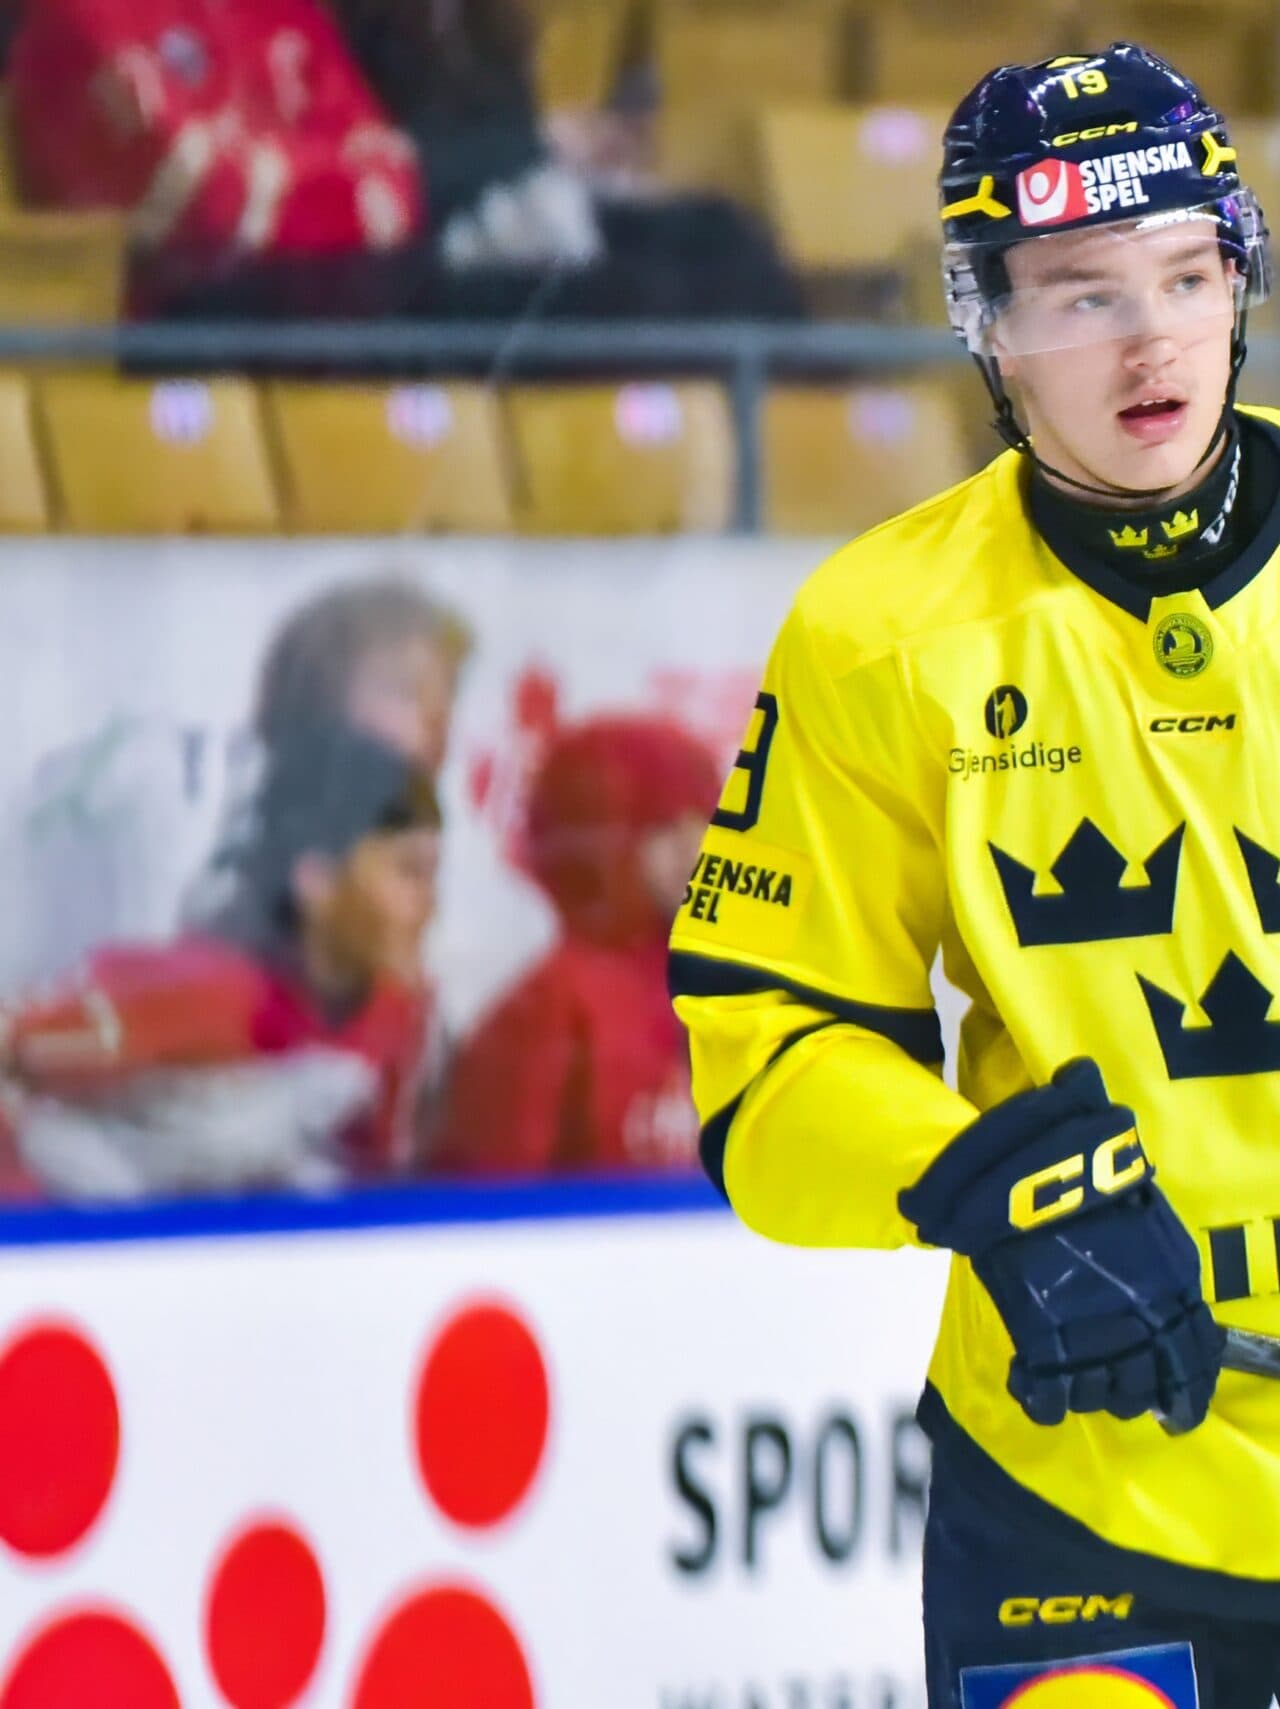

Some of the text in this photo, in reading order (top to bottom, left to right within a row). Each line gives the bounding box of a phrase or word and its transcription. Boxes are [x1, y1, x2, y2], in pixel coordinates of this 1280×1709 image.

[1060, 69, 1108, 99] 19
[1051, 121, 1138, 148] CCM
[1078, 141, 1193, 188] SVENSKA
[1083, 178, 1150, 215] SPEL
[1150, 713, 1236, 734] CCM
[948, 741, 1082, 781] Gjensidige
[997, 1593, 1134, 1627] CCM
